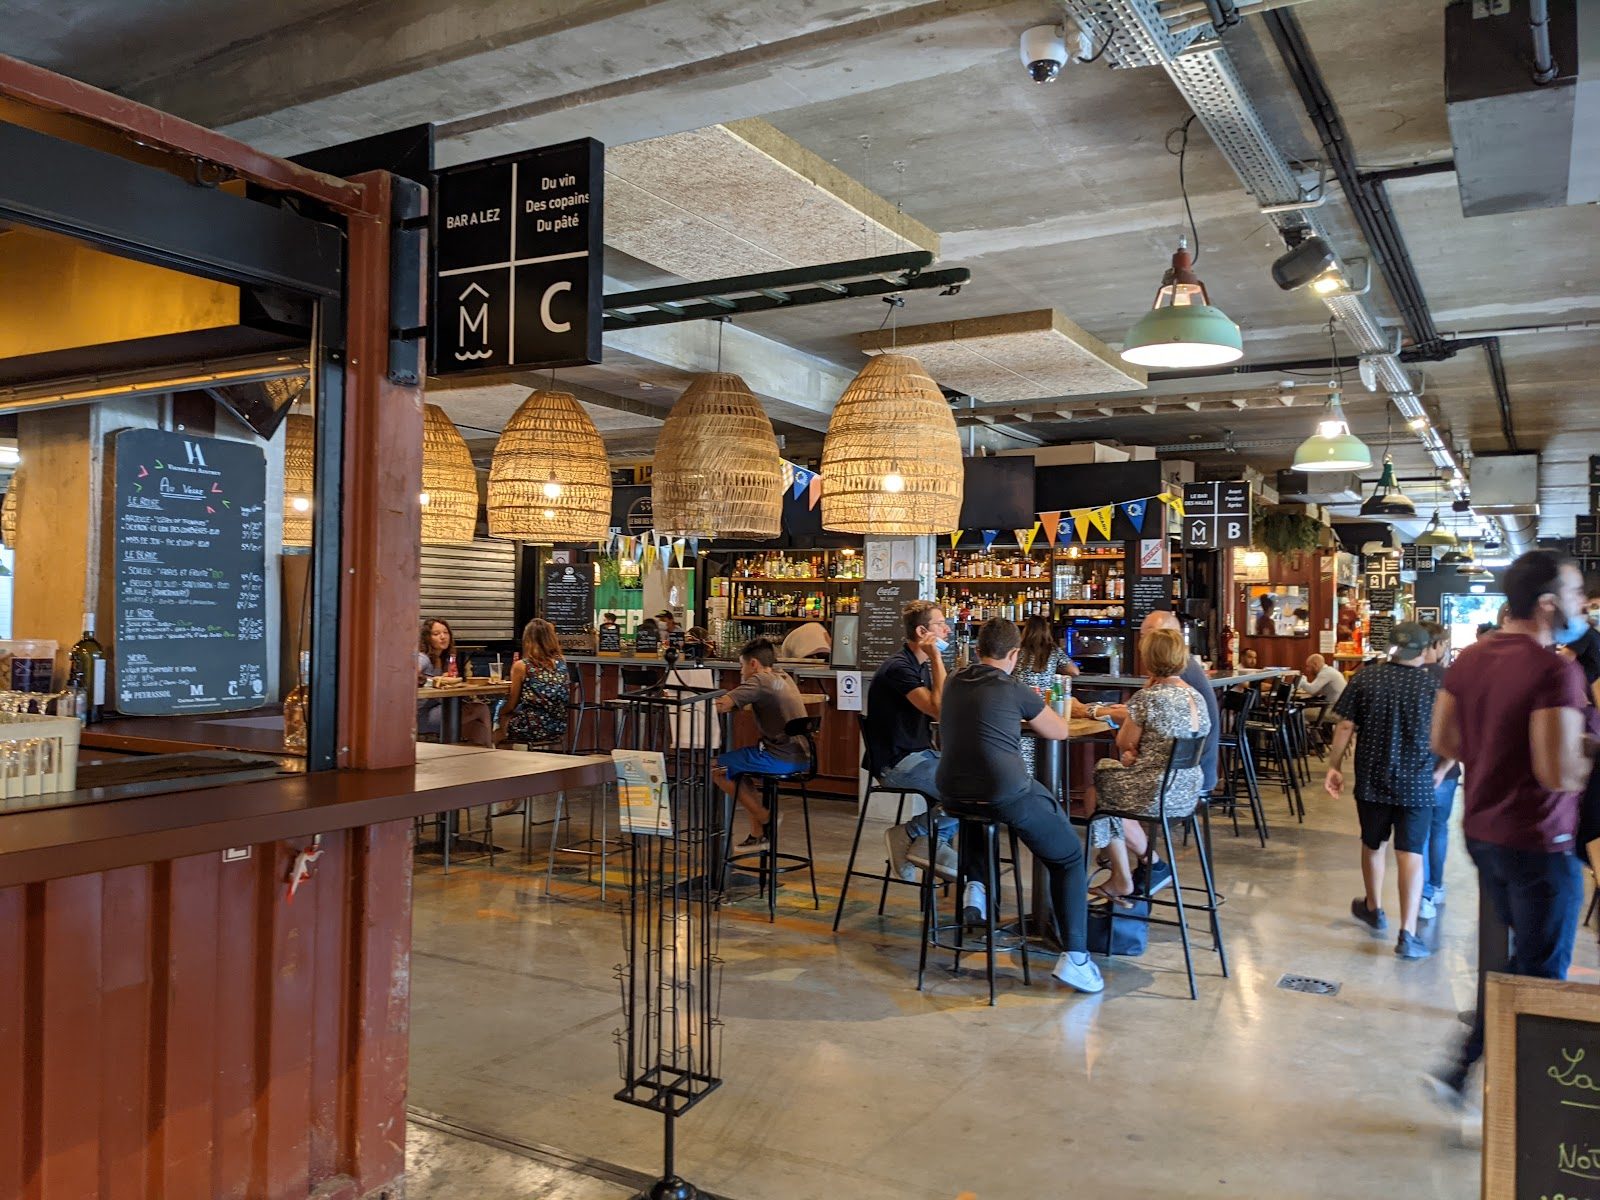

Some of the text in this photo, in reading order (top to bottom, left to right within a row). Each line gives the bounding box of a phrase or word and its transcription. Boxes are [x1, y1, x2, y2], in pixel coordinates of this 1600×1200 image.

[541, 173, 576, 191] Du vin
[525, 192, 590, 213] Des copains
[446, 208, 501, 229] BAR A LEZ
[536, 213, 579, 232] Du pâté
[539, 281, 573, 333] C
[1227, 522, 1242, 540] B
[1388, 576, 1398, 586] A
